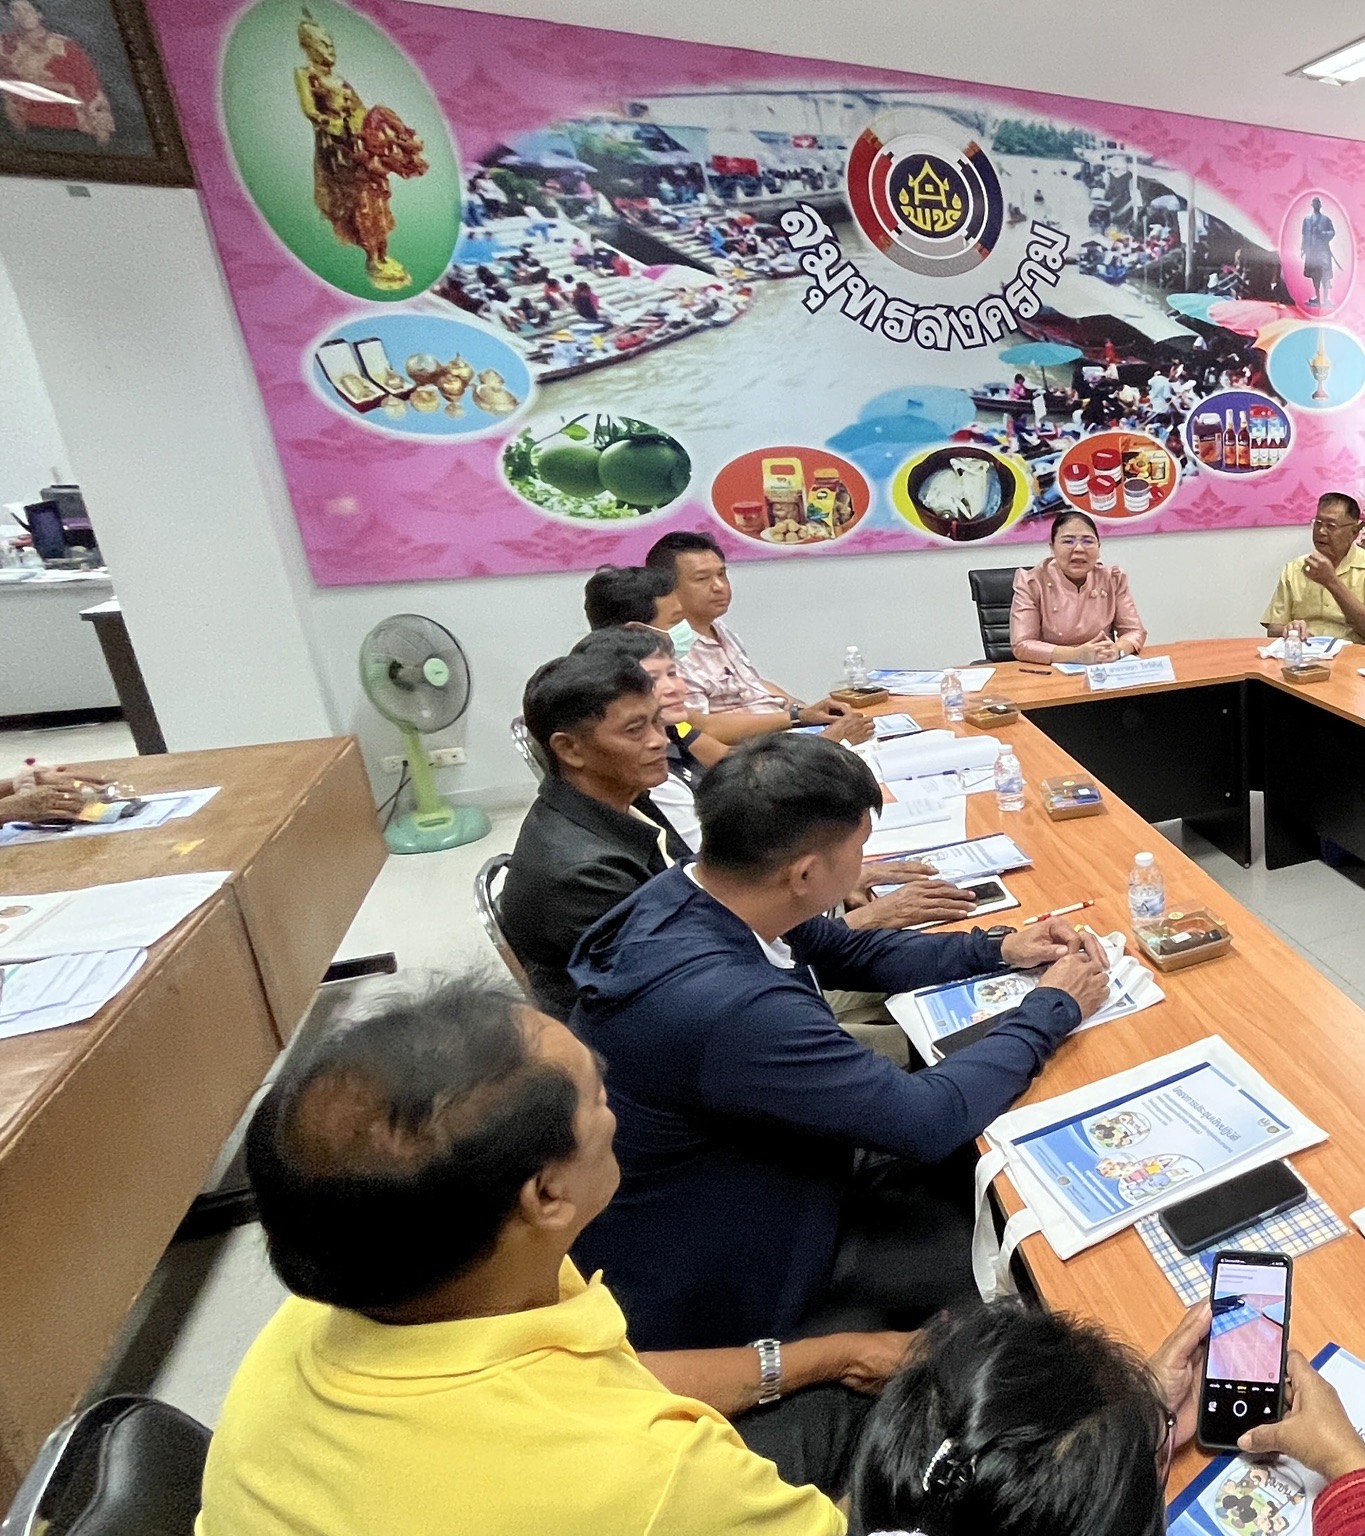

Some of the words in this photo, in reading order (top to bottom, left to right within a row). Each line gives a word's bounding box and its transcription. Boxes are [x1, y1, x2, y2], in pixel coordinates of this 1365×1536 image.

[780, 201, 1070, 351] สมุทรสงคราม
